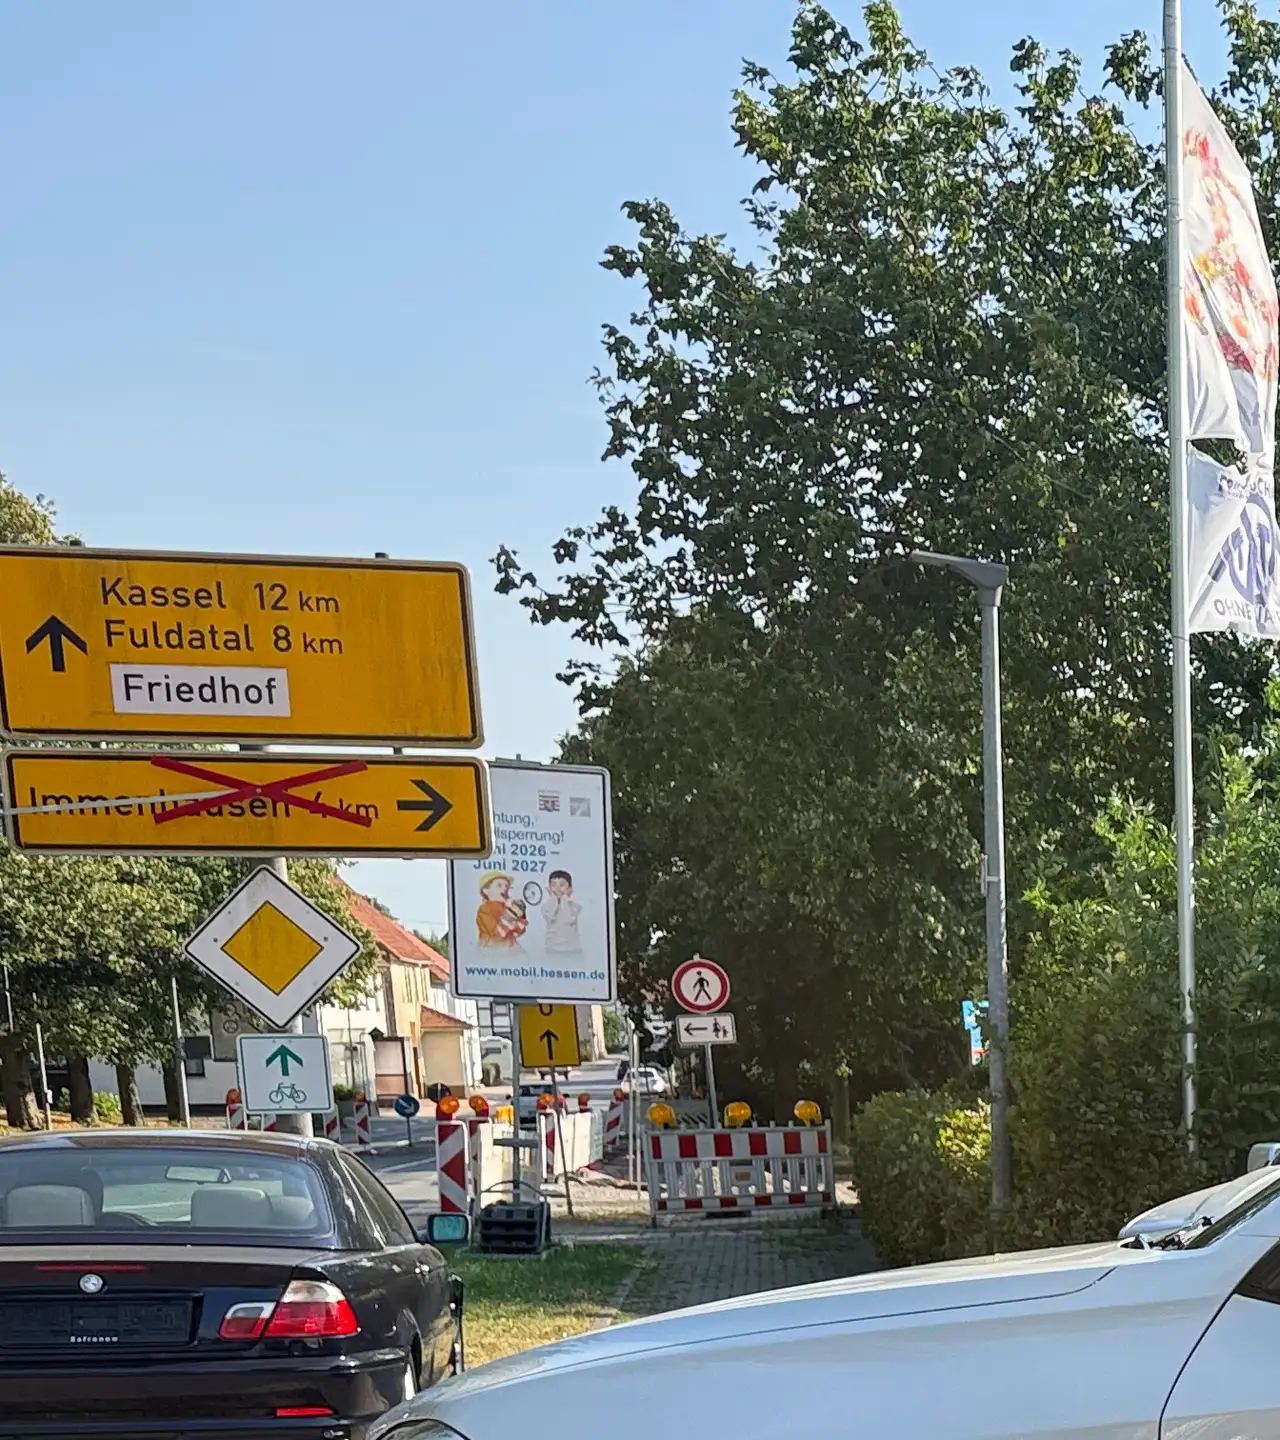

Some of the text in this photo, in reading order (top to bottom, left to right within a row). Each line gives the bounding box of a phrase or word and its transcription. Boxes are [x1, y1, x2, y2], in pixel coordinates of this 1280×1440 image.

[101, 577, 340, 613] Kassel 12 km
[105, 618, 344, 655] Fuldatal 8 km
[123, 673, 277, 705] Friedhof
[493, 811, 534, 828] htung,
[494, 826, 564, 846] llsperrung!
[493, 842, 506, 855] ni
[510, 843, 547, 857] 2026
[473, 858, 548, 873] Juni 2027
[465, 966, 606, 980] www.mobil.hessen.de
